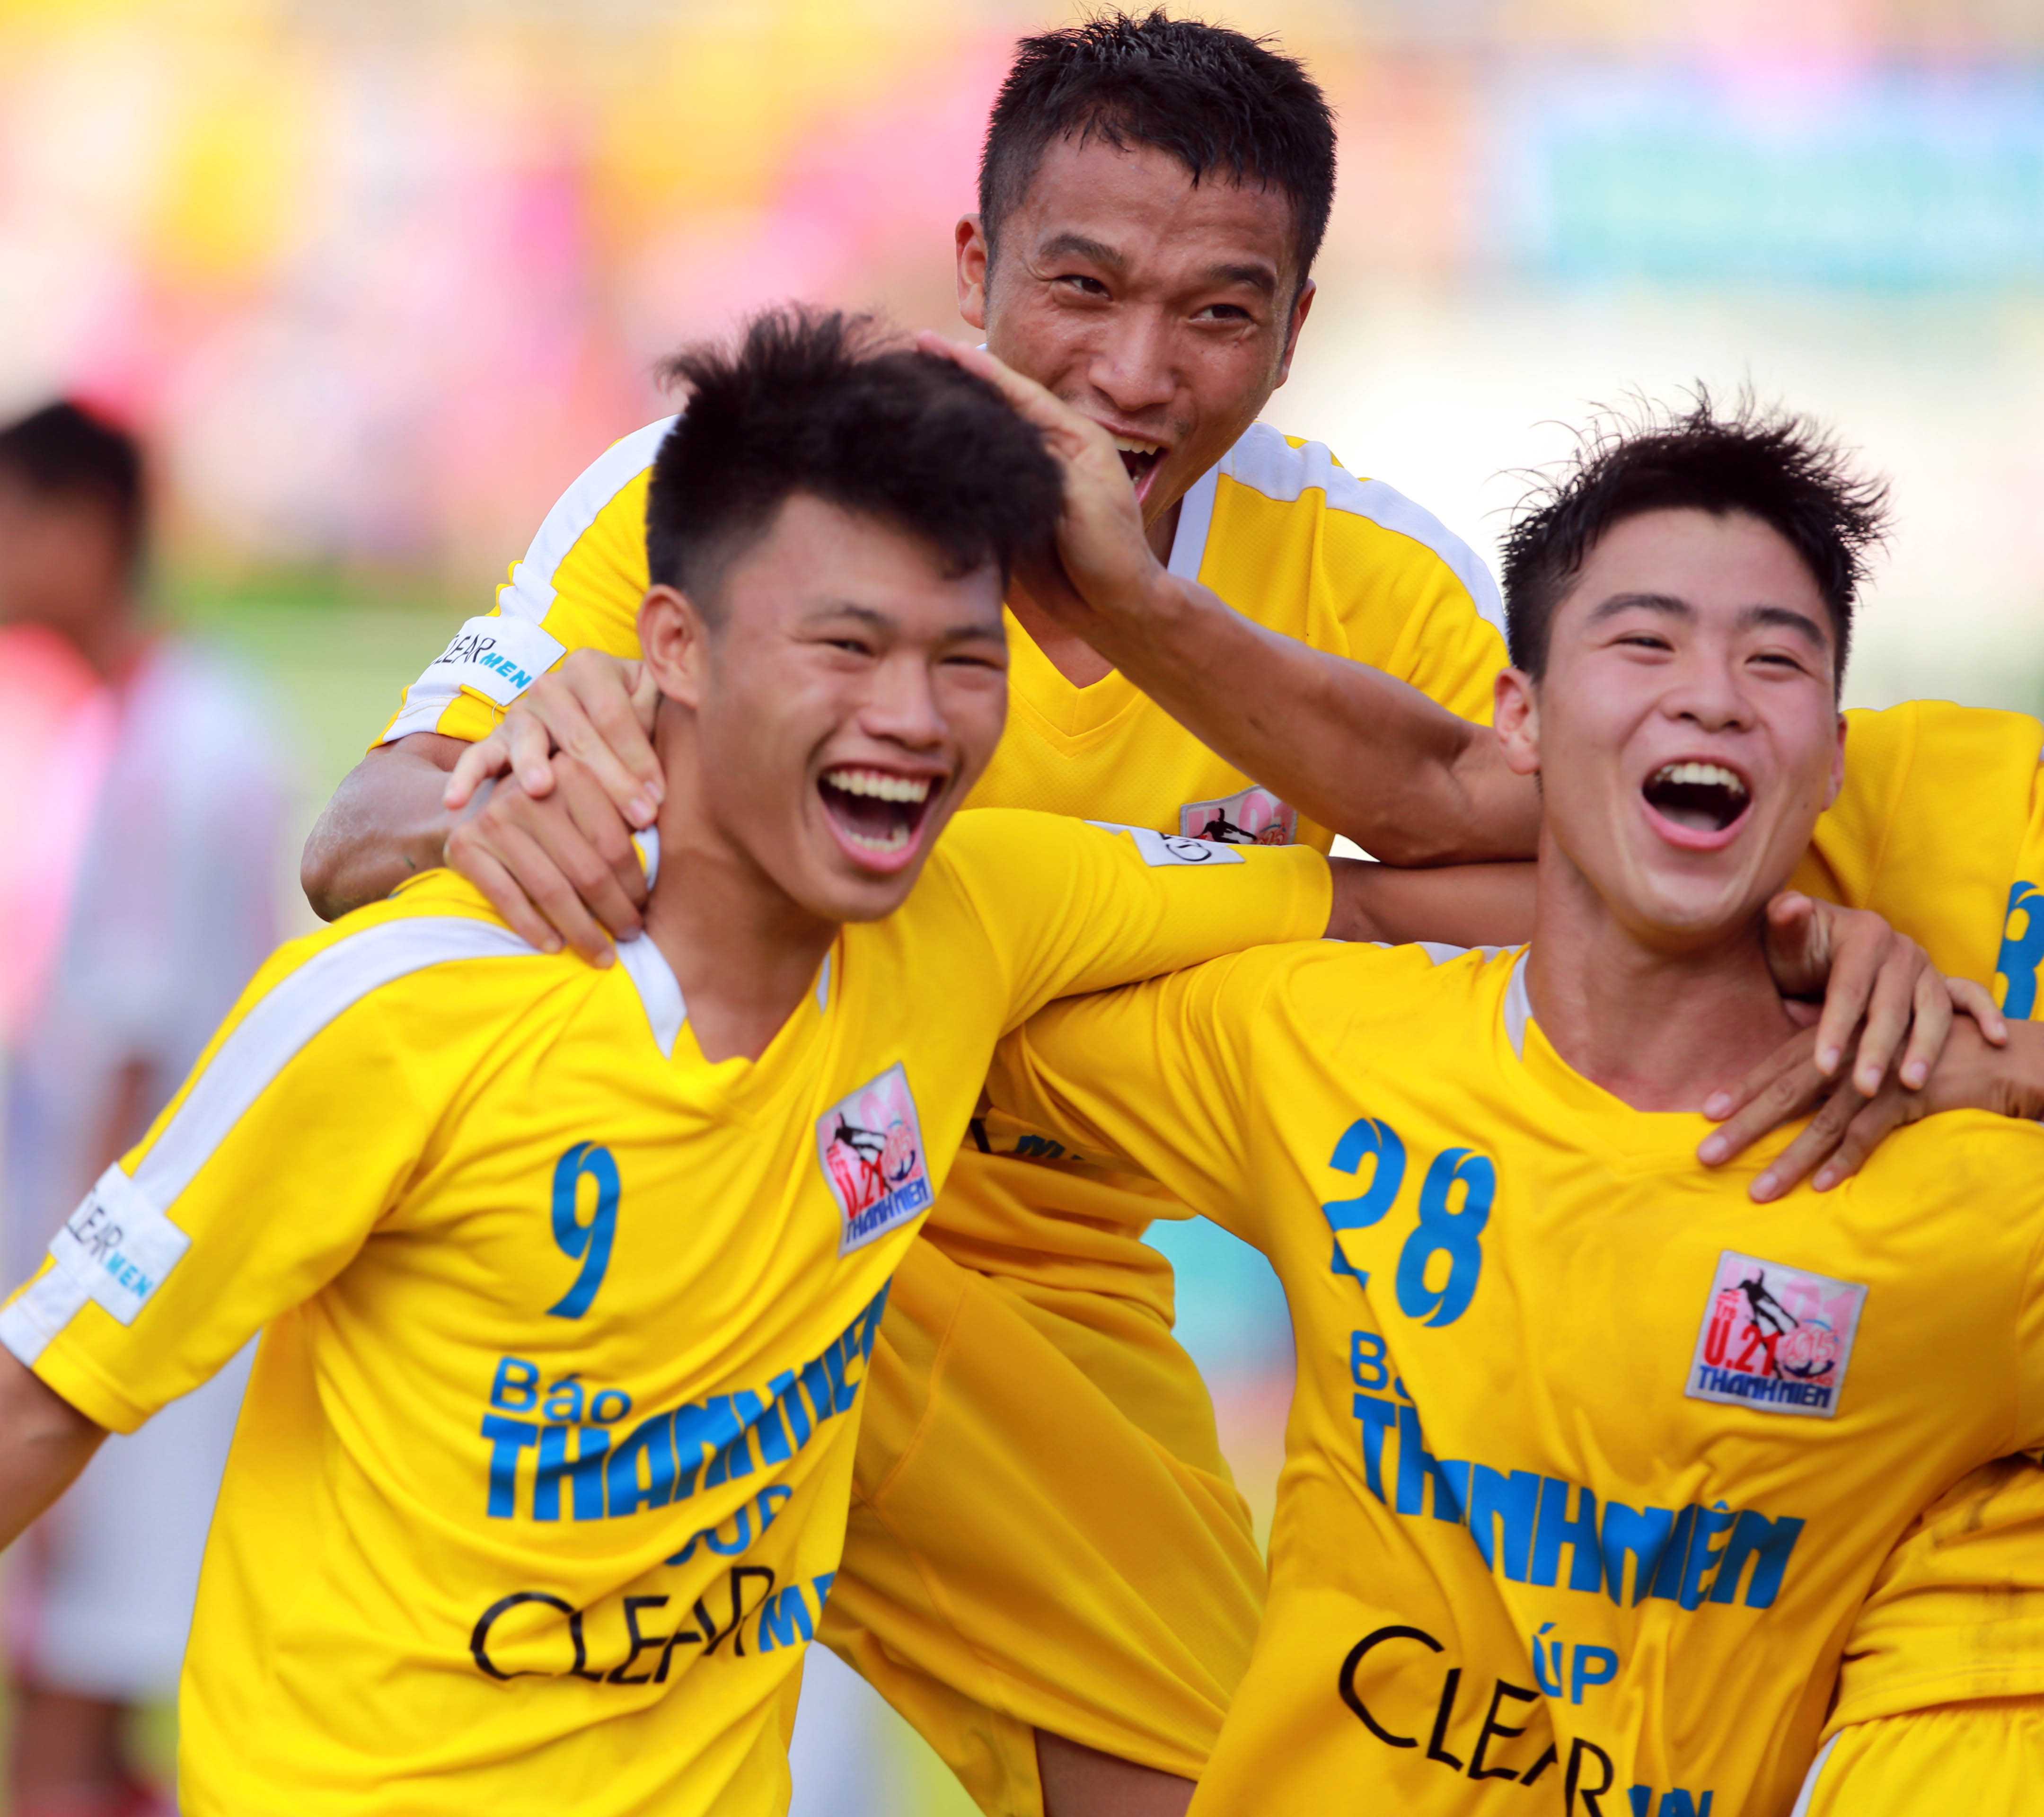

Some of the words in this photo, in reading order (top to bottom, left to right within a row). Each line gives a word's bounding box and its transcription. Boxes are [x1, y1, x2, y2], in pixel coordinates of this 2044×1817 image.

[432, 633, 496, 664] LEAR
[479, 652, 532, 689] MEN
[544, 1140, 621, 1321] 9
[1321, 1117, 1497, 1328] 28
[1704, 1317, 1781, 1376] U.21
[490, 1356, 633, 1425] Báo
